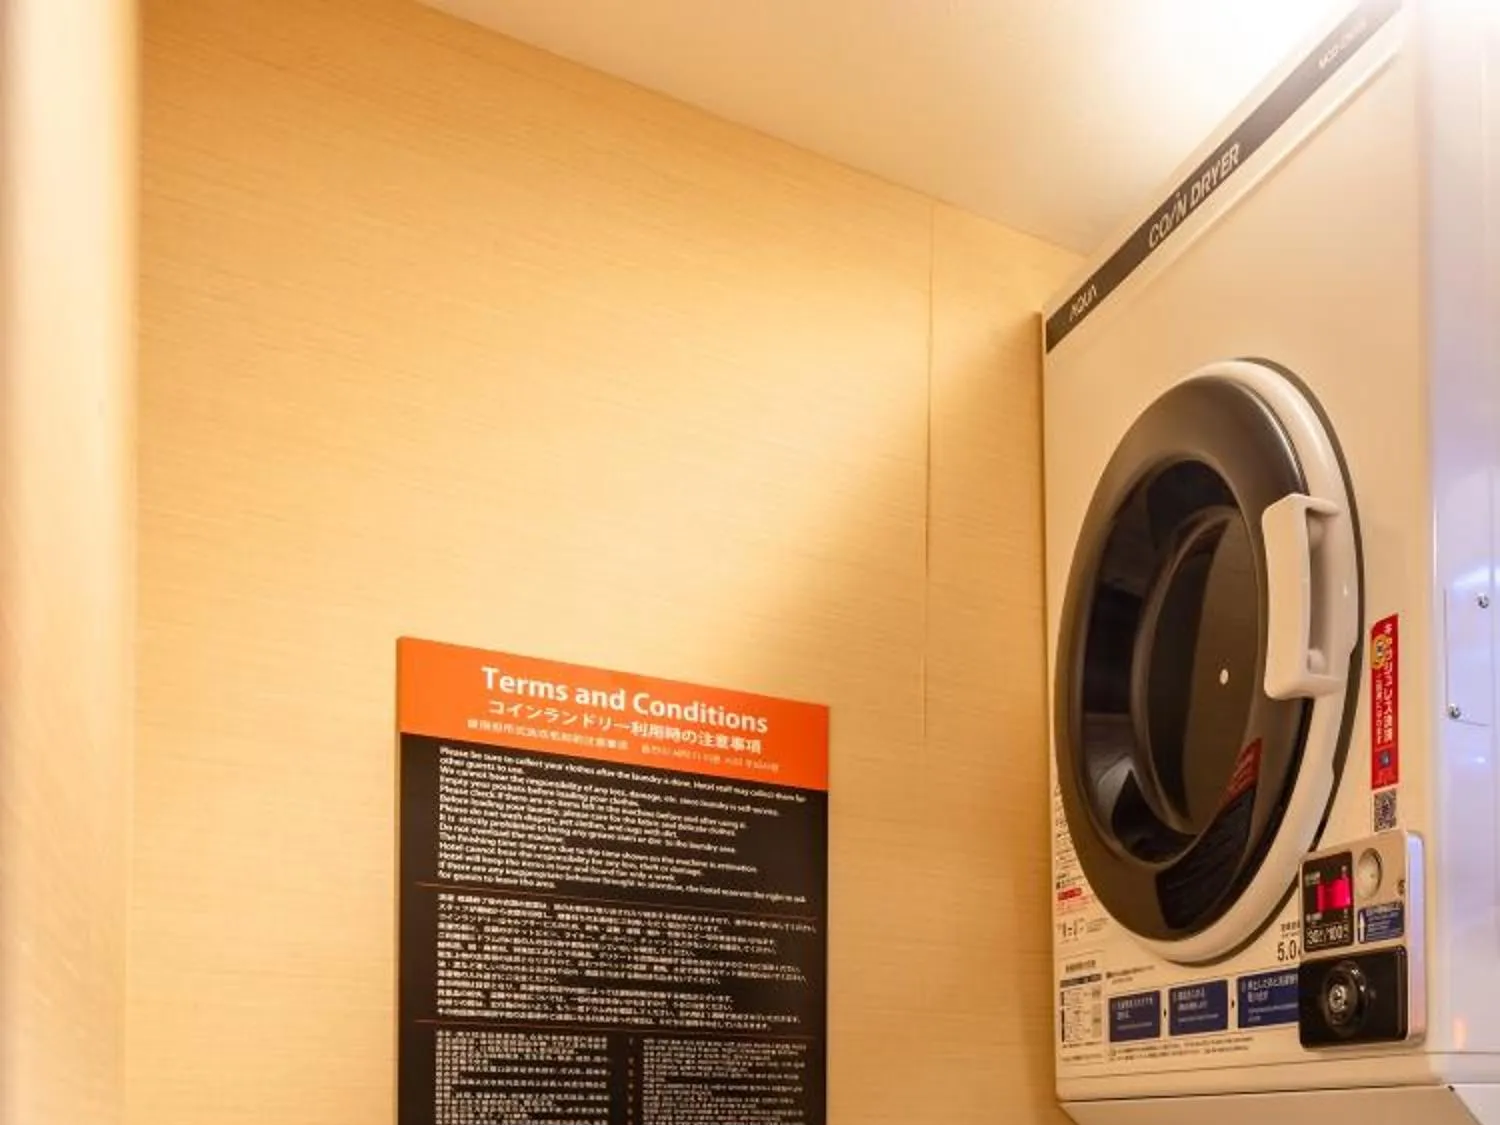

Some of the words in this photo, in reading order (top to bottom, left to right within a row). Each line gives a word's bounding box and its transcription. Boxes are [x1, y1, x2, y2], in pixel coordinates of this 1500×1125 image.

[1190, 143, 1239, 208] DRYER
[481, 666, 568, 701] Terms
[575, 687, 625, 711] and
[632, 691, 768, 734] Conditions
[489, 699, 762, 754] コインランドリー利用時の注意事項
